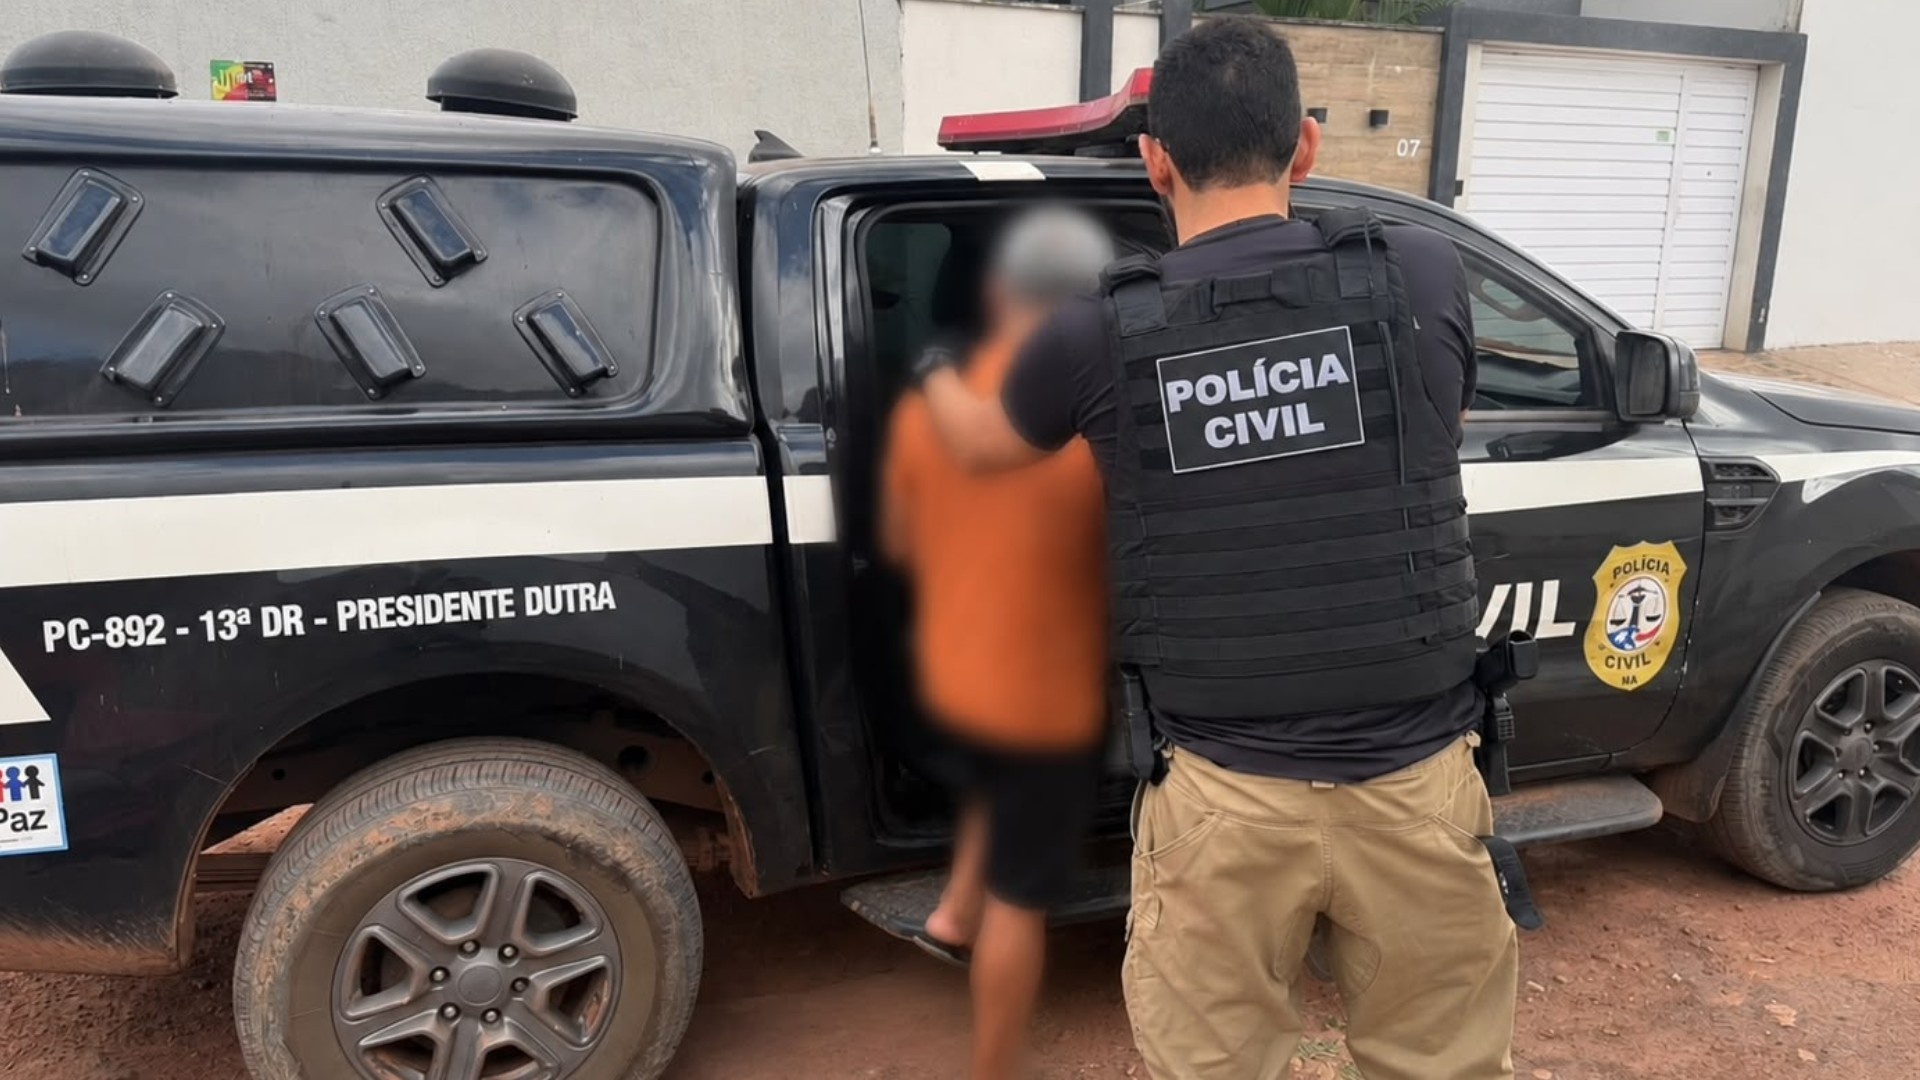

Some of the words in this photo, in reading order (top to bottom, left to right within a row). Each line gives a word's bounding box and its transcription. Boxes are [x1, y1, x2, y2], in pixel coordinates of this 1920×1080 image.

[1396, 138, 1421, 157] 07
[1166, 353, 1350, 413] POLÍCIA
[1204, 402, 1326, 448] CIVIL
[1612, 554, 1670, 580] POLÍCIA
[43, 613, 167, 652] PC-892
[176, 626, 190, 635] -
[199, 607, 251, 642] 13ª
[261, 604, 306, 637] DR
[314, 616, 328, 625] -
[336, 588, 516, 632] PRESIDENTE
[524, 580, 617, 616] DUTRA
[1604, 652, 1652, 670] CIVIL
